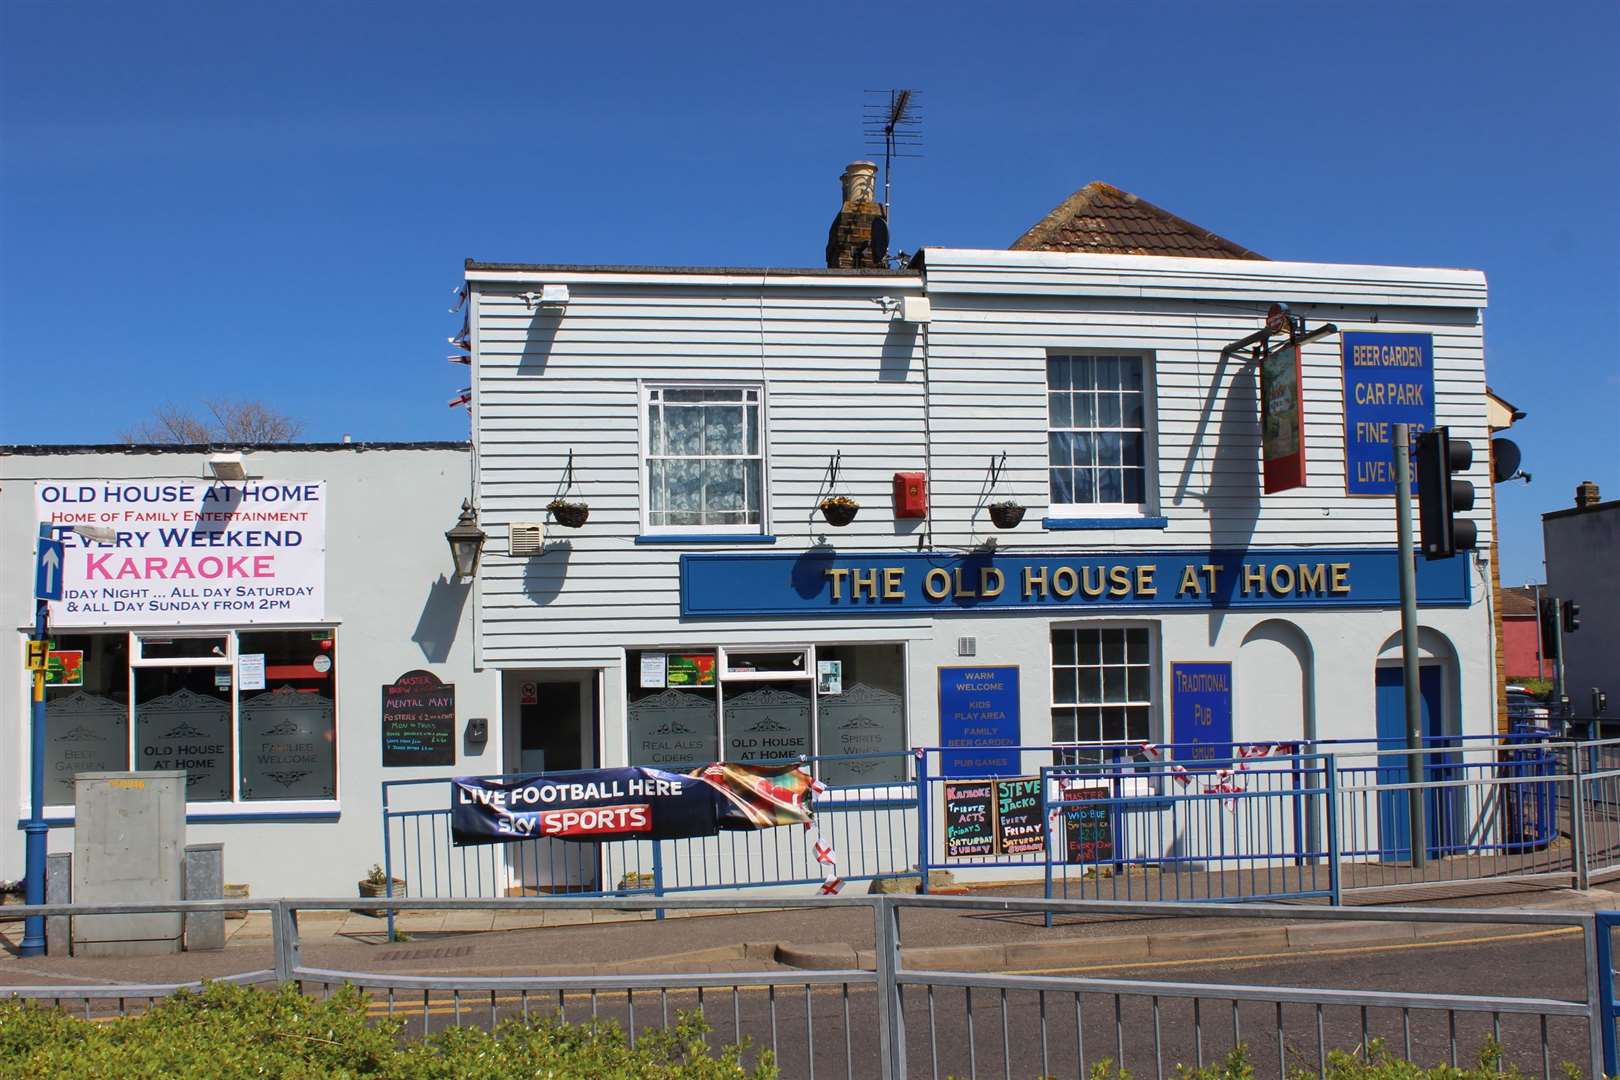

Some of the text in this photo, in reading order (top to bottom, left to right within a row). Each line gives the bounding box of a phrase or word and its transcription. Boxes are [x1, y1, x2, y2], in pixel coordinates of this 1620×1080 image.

[1354, 345, 1423, 367] BEER GARDEN
[1355, 382, 1424, 406] CAR PARK
[1356, 421, 1389, 443] FINE
[1358, 461, 1417, 482] LIVE MSI
[42, 485, 319, 503] OLD HOUSE AT HOME
[52, 511, 309, 523] HOME OF FAMILY ENTERTAINMENT
[159, 528, 303, 547] WEEKEND
[86, 553, 275, 580] KARAOKE
[825, 562, 1352, 599] THE OLD HOUSE AT HOME
[103, 588, 149, 599] NIGHT
[171, 587, 199, 598] ALL
[203, 588, 231, 598] DAY
[236, 586, 314, 597] SATURDAY
[67, 599, 290, 612] & ALL DAY SUNDAY FROM 2PM
[28, 643, 46, 667] H
[964, 672, 995, 680] WARM
[1176, 671, 1229, 692] TRADITIONAL
[956, 683, 1004, 691] WELCOME
[387, 697, 424, 708] MENTAL
[969, 701, 992, 709] KIDS
[955, 711, 1006, 720] PLAY AREA
[1194, 703, 1212, 726] PUB
[964, 728, 999, 736] FAMILY
[643, 740, 703, 750] REAL ALES
[732, 737, 805, 749] OLD HOUSE
[841, 734, 882, 744] SPIRITS
[948, 739, 1013, 747] BEER GARDEN
[144, 744, 225, 756] OLD HOUSE
[741, 750, 796, 761] AT HOME
[257, 754, 318, 764] WELCOME
[652, 753, 694, 762] CIDERS
[954, 758, 1008, 768] PUB GAMES
[153, 759, 215, 769] AT HOME
[459, 779, 683, 805] LIVE FOOTBALL HERE
[999, 780, 1041, 798] STEVE
[1000, 798, 1036, 813] JACKO
[545, 807, 647, 833] SPORTS
[959, 812, 985, 823] ACTS
[1004, 824, 1042, 836] FRIDAY
[949, 836, 993, 847] SATURDAY
